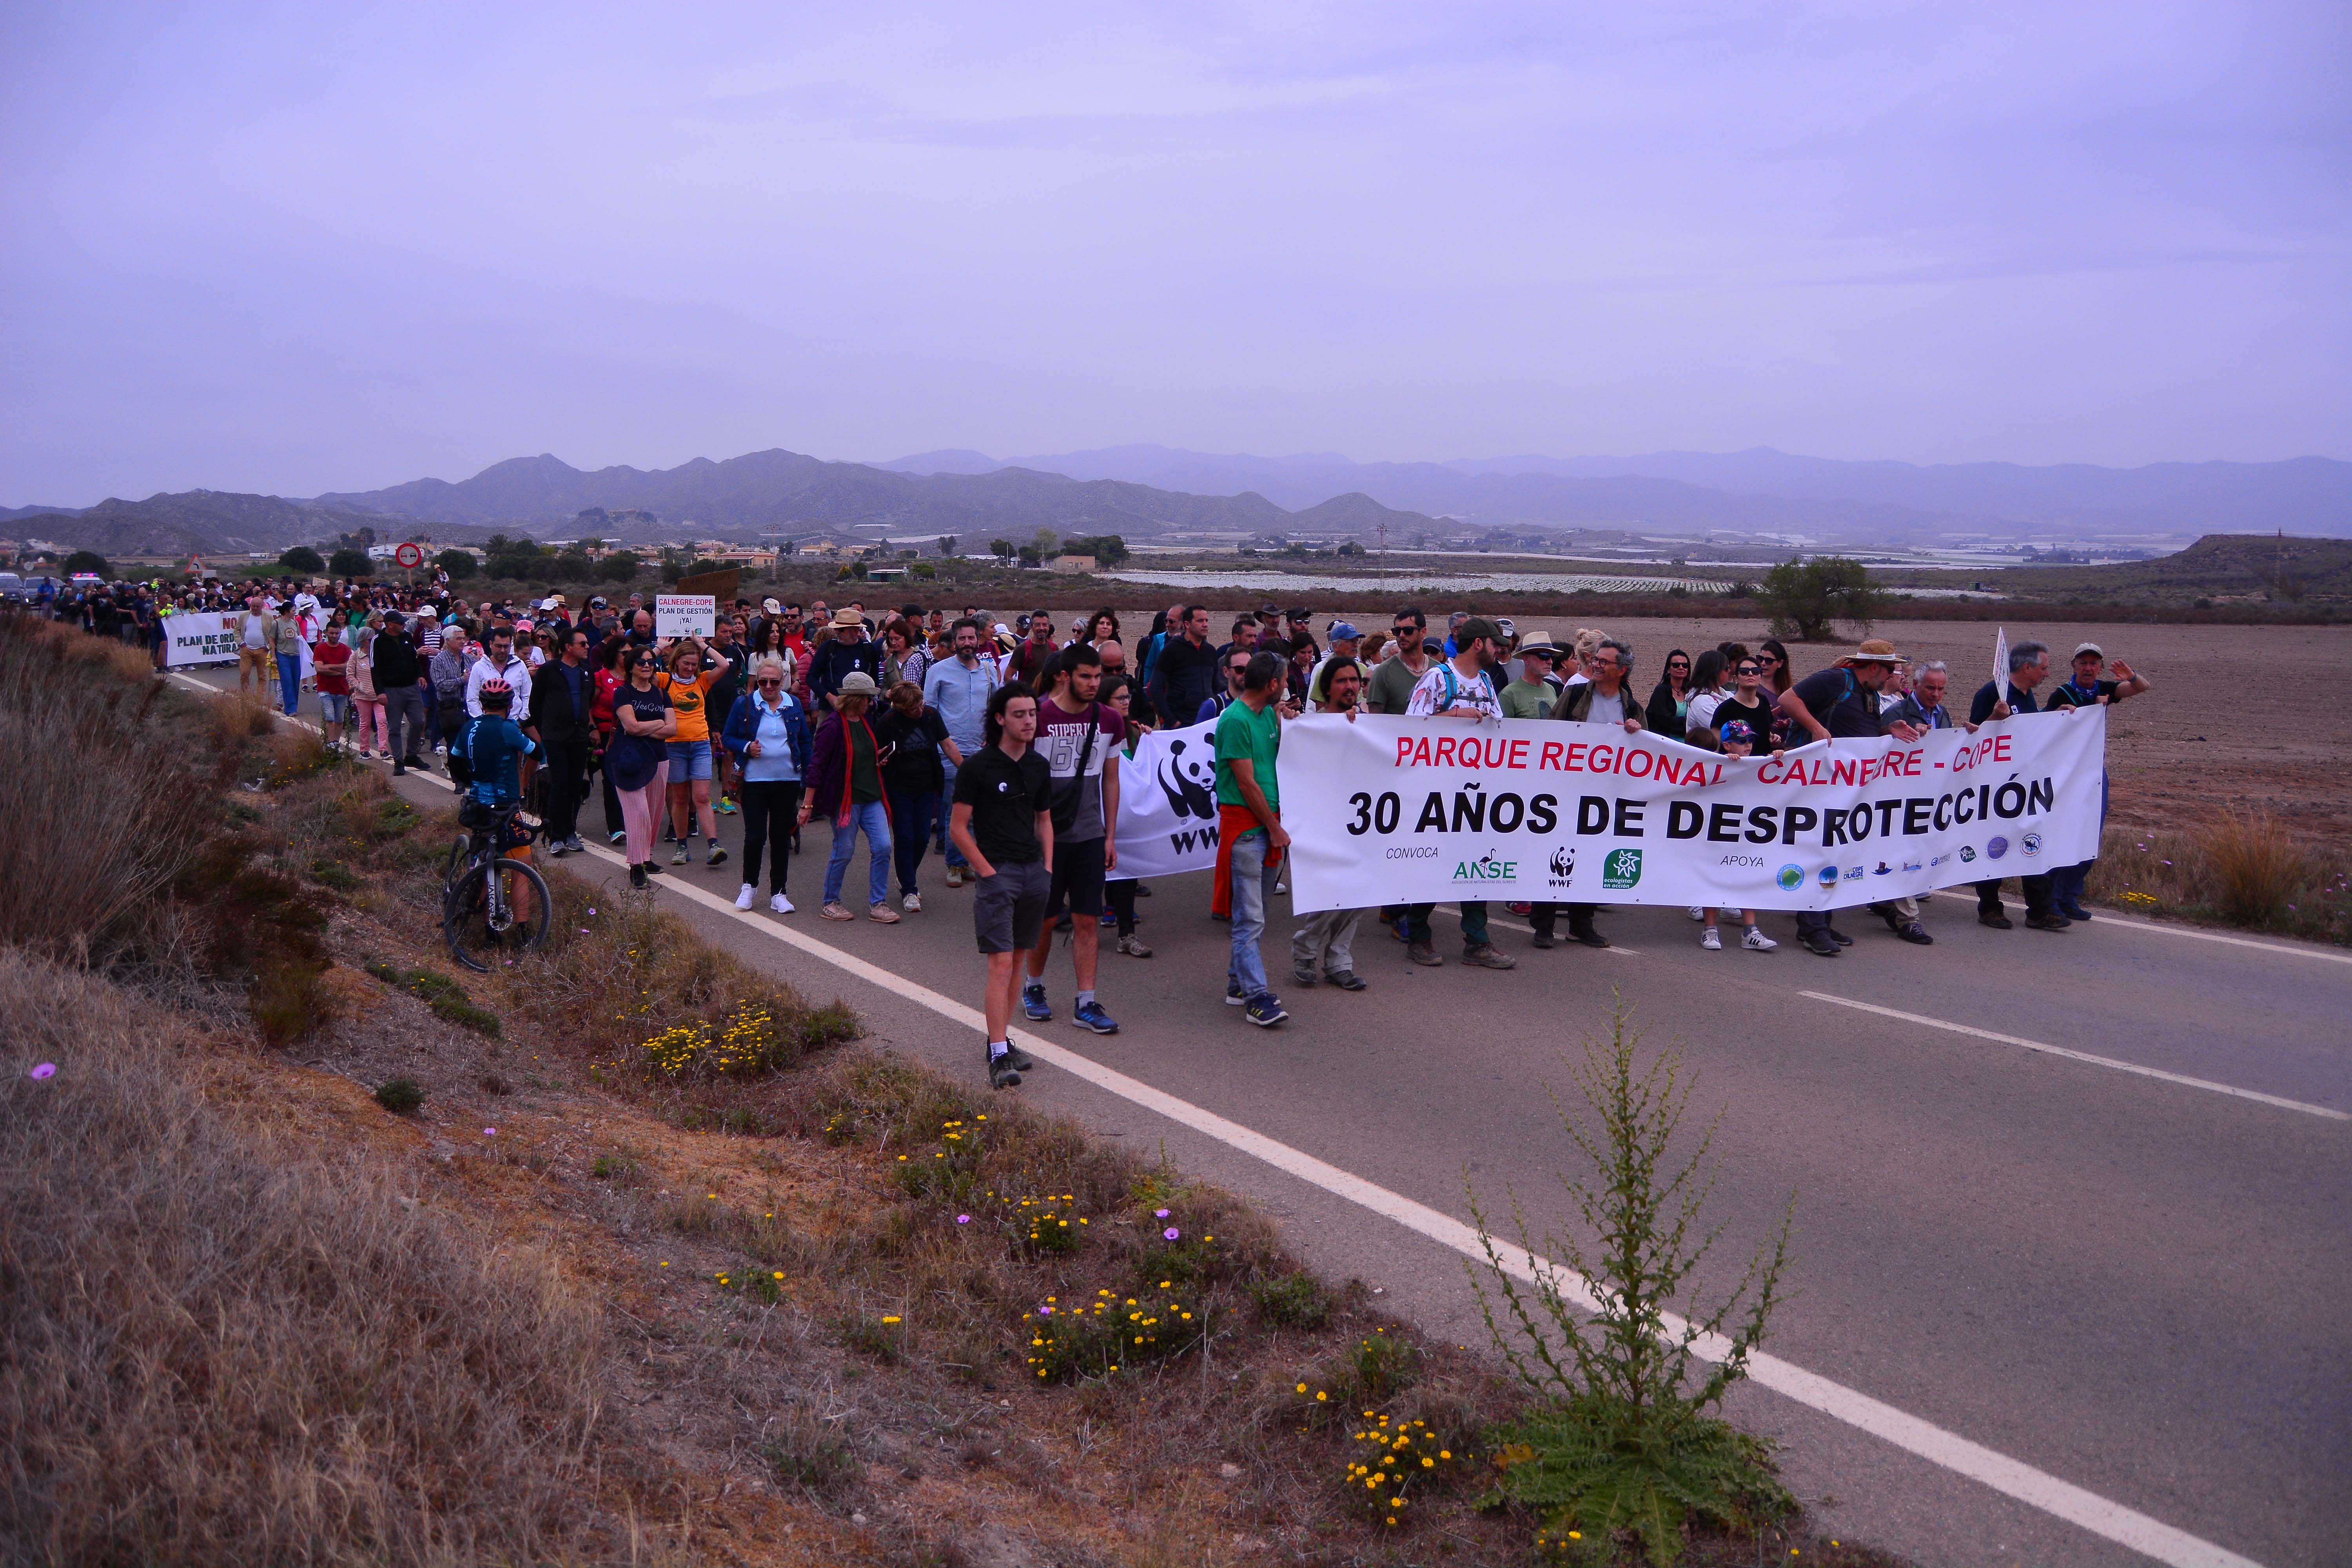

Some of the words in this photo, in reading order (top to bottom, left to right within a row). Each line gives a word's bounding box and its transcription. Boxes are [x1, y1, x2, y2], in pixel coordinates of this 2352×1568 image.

[177, 635, 202, 647] PLAN
[205, 634, 218, 644] DE
[1395, 737, 1530, 770] PARQUE
[1539, 741, 1727, 787] REGIONAL
[1757, 748, 1924, 787] CALNEGRE
[1953, 735, 2012, 773] COPE
[1346, 791, 1401, 835] 30
[1414, 782, 1558, 835] AÑOS
[1576, 795, 1648, 837] DE
[1666, 773, 2054, 847] DESPROTECCIÓN
[1170, 826, 1220, 855] WW
[1386, 847, 1438, 859] CONVOCA
[1720, 855, 1764, 868] APOYA
[1453, 861, 1517, 879] ANSE
[1548, 879, 1573, 888] WWF
